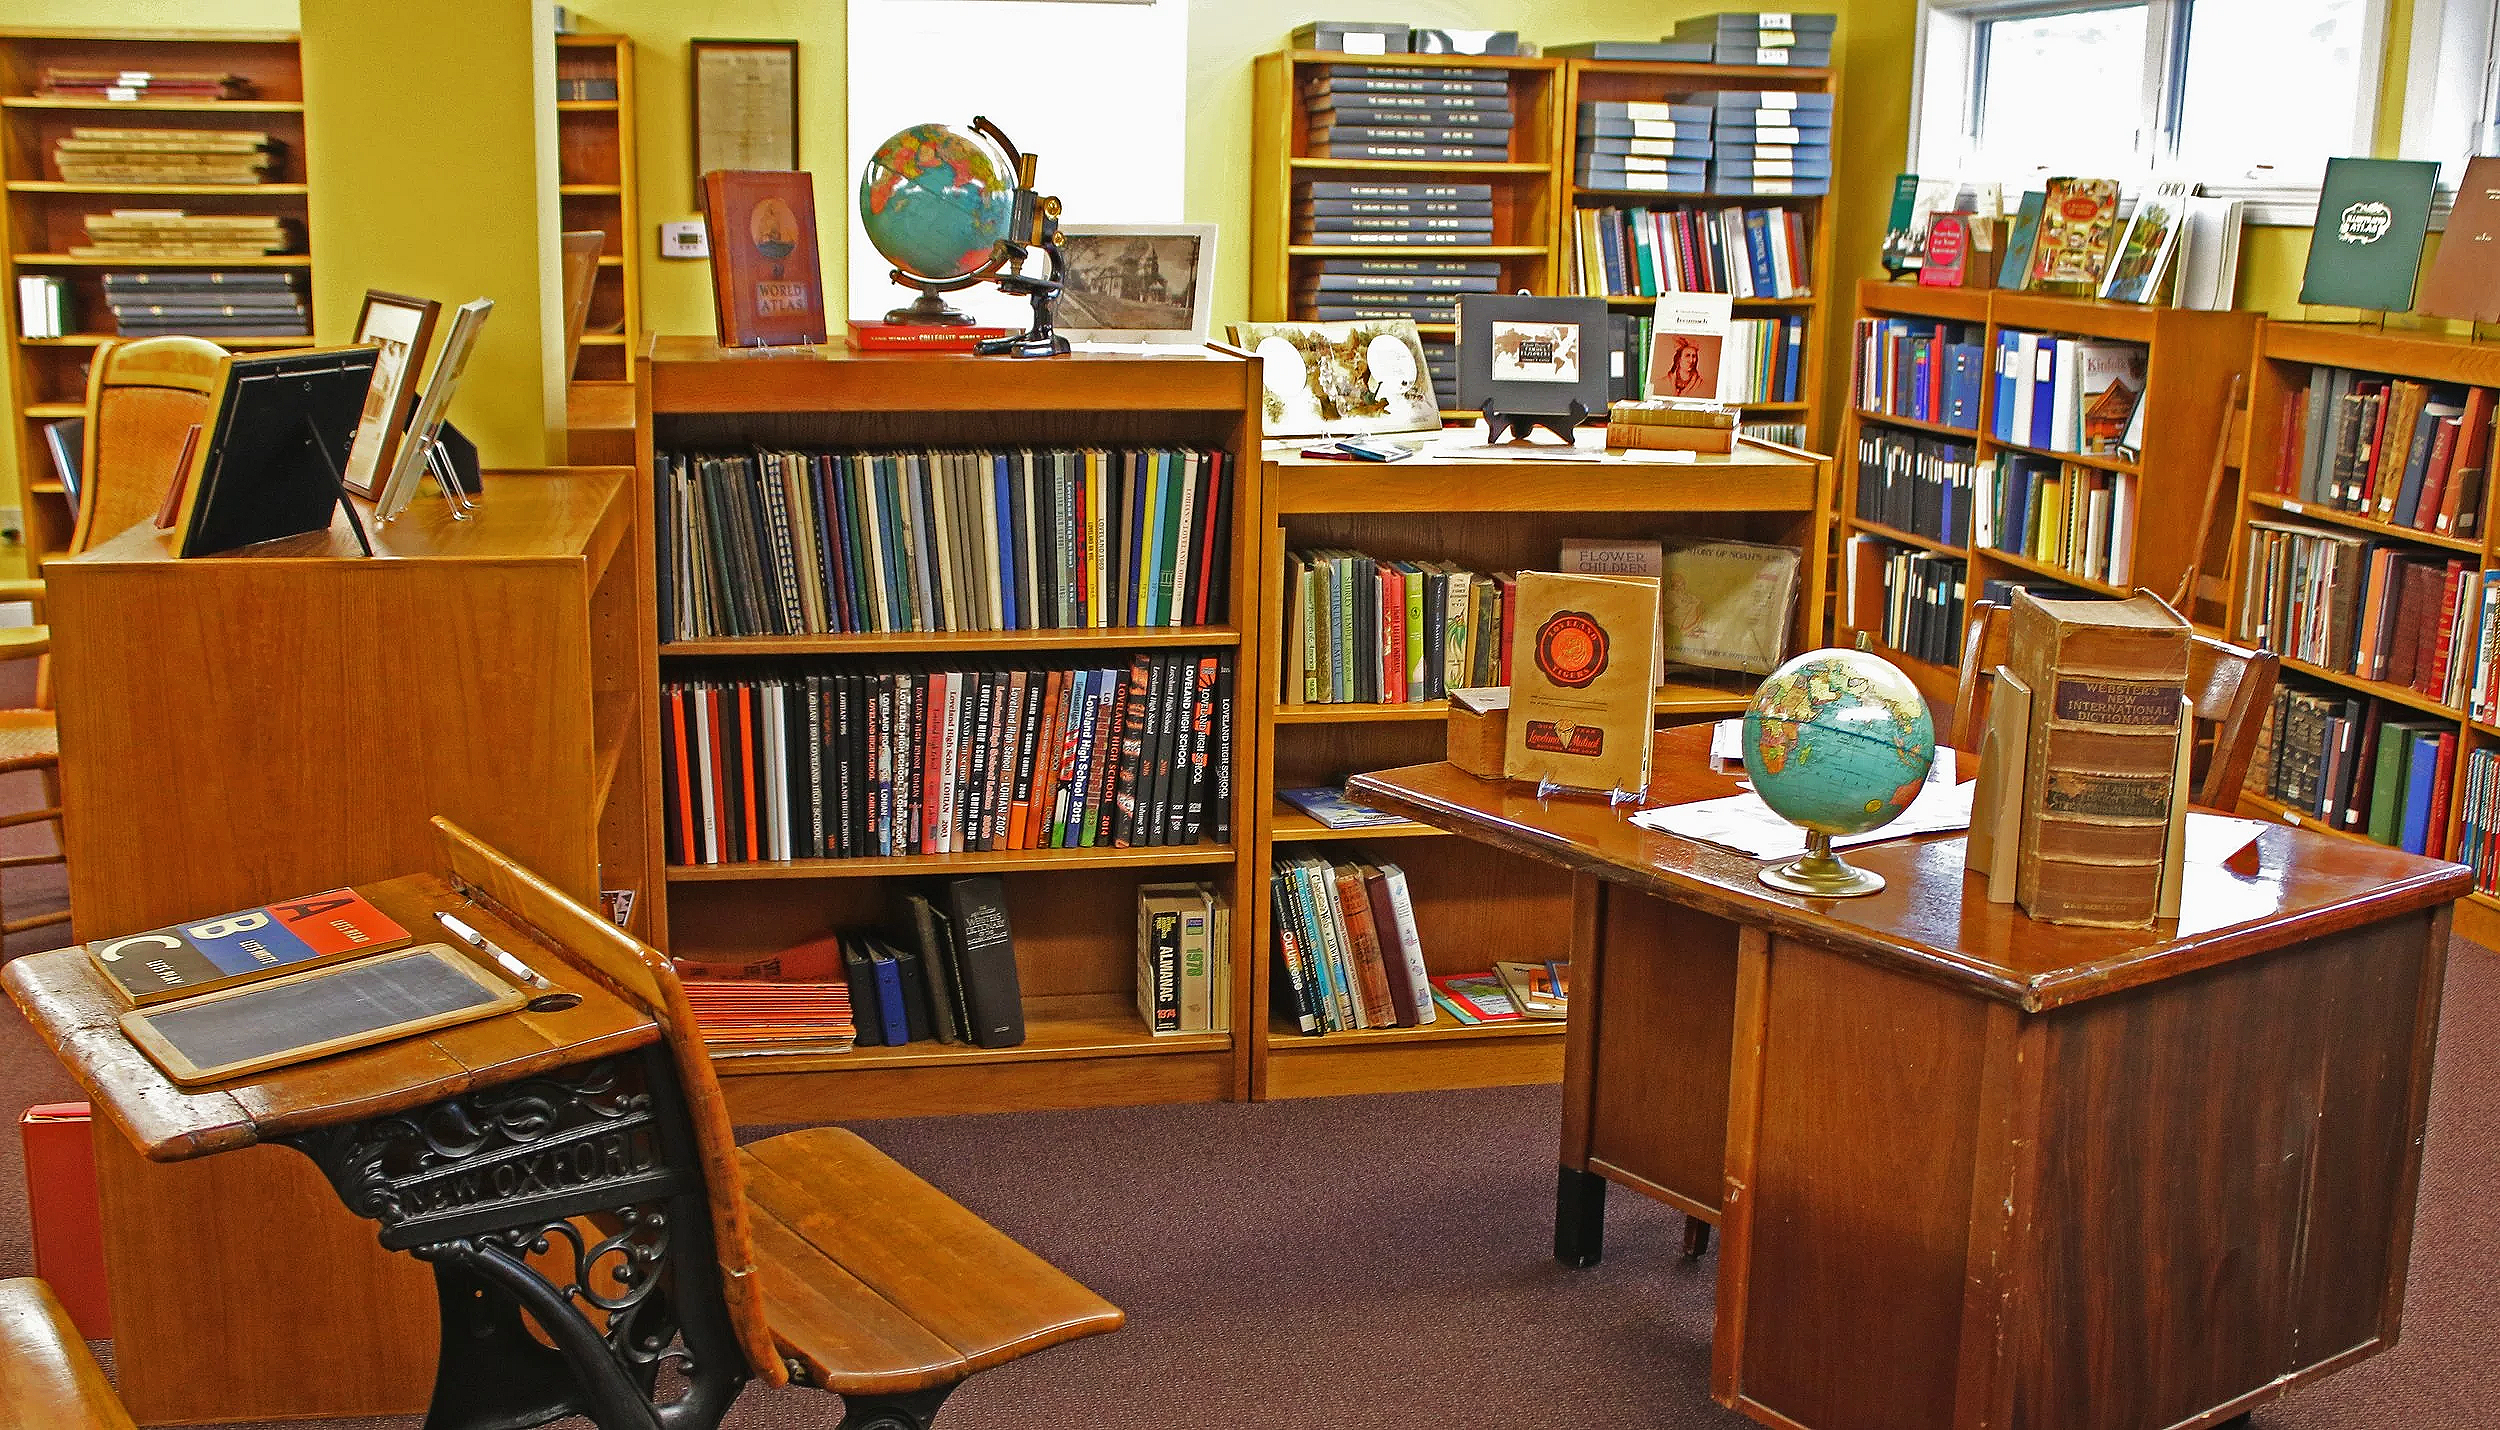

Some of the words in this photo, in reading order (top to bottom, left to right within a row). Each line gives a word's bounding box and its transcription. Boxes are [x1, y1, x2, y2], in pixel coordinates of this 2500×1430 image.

[760, 284, 801, 297] WORLD
[761, 300, 806, 313] ATLAS
[1579, 551, 1644, 562] FLOWER
[1579, 562, 1647, 573] CHILDREN
[1550, 619, 1598, 641] LOVELAND
[1150, 666, 1160, 695] Loveland
[1167, 665, 1177, 695] Loveland
[1552, 666, 1590, 679] TIGERS
[1182, 665, 1194, 709] LOVELAND
[2086, 683, 2160, 696] WEBSTER'S
[898, 689, 906, 730] LOVELAND
[914, 688, 923, 720] LOVELAND
[948, 691, 956, 726] Loveland
[978, 685, 991, 721] LOVELAND
[992, 686, 1005, 726] Loveland
[1007, 688, 1019, 724] Loveland
[1029, 687, 1039, 715] LOVELAND
[1113, 683, 1126, 732] LOVELAND
[1148, 696, 1157, 712] High
[1164, 696, 1174, 712] High
[1198, 688, 1210, 730] LOVELAND
[2068, 700, 2169, 716] INTERNATIONAL
[2107, 695, 2137, 705] NEW
[963, 696, 972, 735] LOVELAND
[1027, 717, 1036, 731] HIGH
[1081, 695, 1098, 738] Loveland
[1147, 712, 1155, 734] School
[1163, 712, 1172, 735] School
[1180, 711, 1190, 732] HIGH
[1221, 698, 1230, 742] LOVELAND
[2077, 711, 2160, 724] DICTIONARY
[946, 729, 954, 747] High
[961, 736, 969, 754] HIGH
[976, 725, 988, 742] HIGH
[989, 728, 1001, 747] High
[1004, 726, 1015, 743] High
[1023, 733, 1034, 755] SCHOOL
[1196, 732, 1207, 752] HIGH
[973, 745, 985, 772] SCHOOL
[1001, 746, 1014, 771] School
[1077, 740, 1093, 762] High
[1109, 736, 1119, 761] HIGH
[1177, 733, 1188, 769] SCHOOL
[1221, 743, 1229, 764] HIGH
[811, 743, 820, 783] LOVELAND
[897, 754, 905, 785] SCHOOL
[959, 754, 968, 785] SCHOOL
[986, 749, 998, 780] School
[1020, 757, 1030, 777] LOHIAN
[1193, 753, 1203, 785] SCHOOL
[912, 773, 920, 798] LOHIAN
[1073, 763, 1088, 797] School
[1104, 764, 1116, 803] SCHOOL
[1220, 765, 1229, 799] SCHOOL
[943, 783, 951, 813] LOHIAN
[969, 792, 980, 818] LOHIAN
[997, 782, 1011, 814] LOHIAN
[813, 808, 821, 840] SCHOOL
[1070, 801, 1082, 824] 2012
[1101, 815, 1110, 835] 2014
[1137, 801, 1146, 824] Volume
[1154, 801, 1163, 824] Volume
[995, 816, 1006, 837] 2007
[277, 897, 355, 923] A
[187, 911, 270, 939] B
[100, 935, 182, 962] C
[1282, 931, 1294, 950] Our
[1160, 946, 1174, 1002] ALMANAC
[1286, 950, 1303, 991] Universe
[1157, 1009, 1176, 1019] 1974
[399, 1180, 479, 1219] NEW
[494, 1128, 656, 1198] OXFORD
